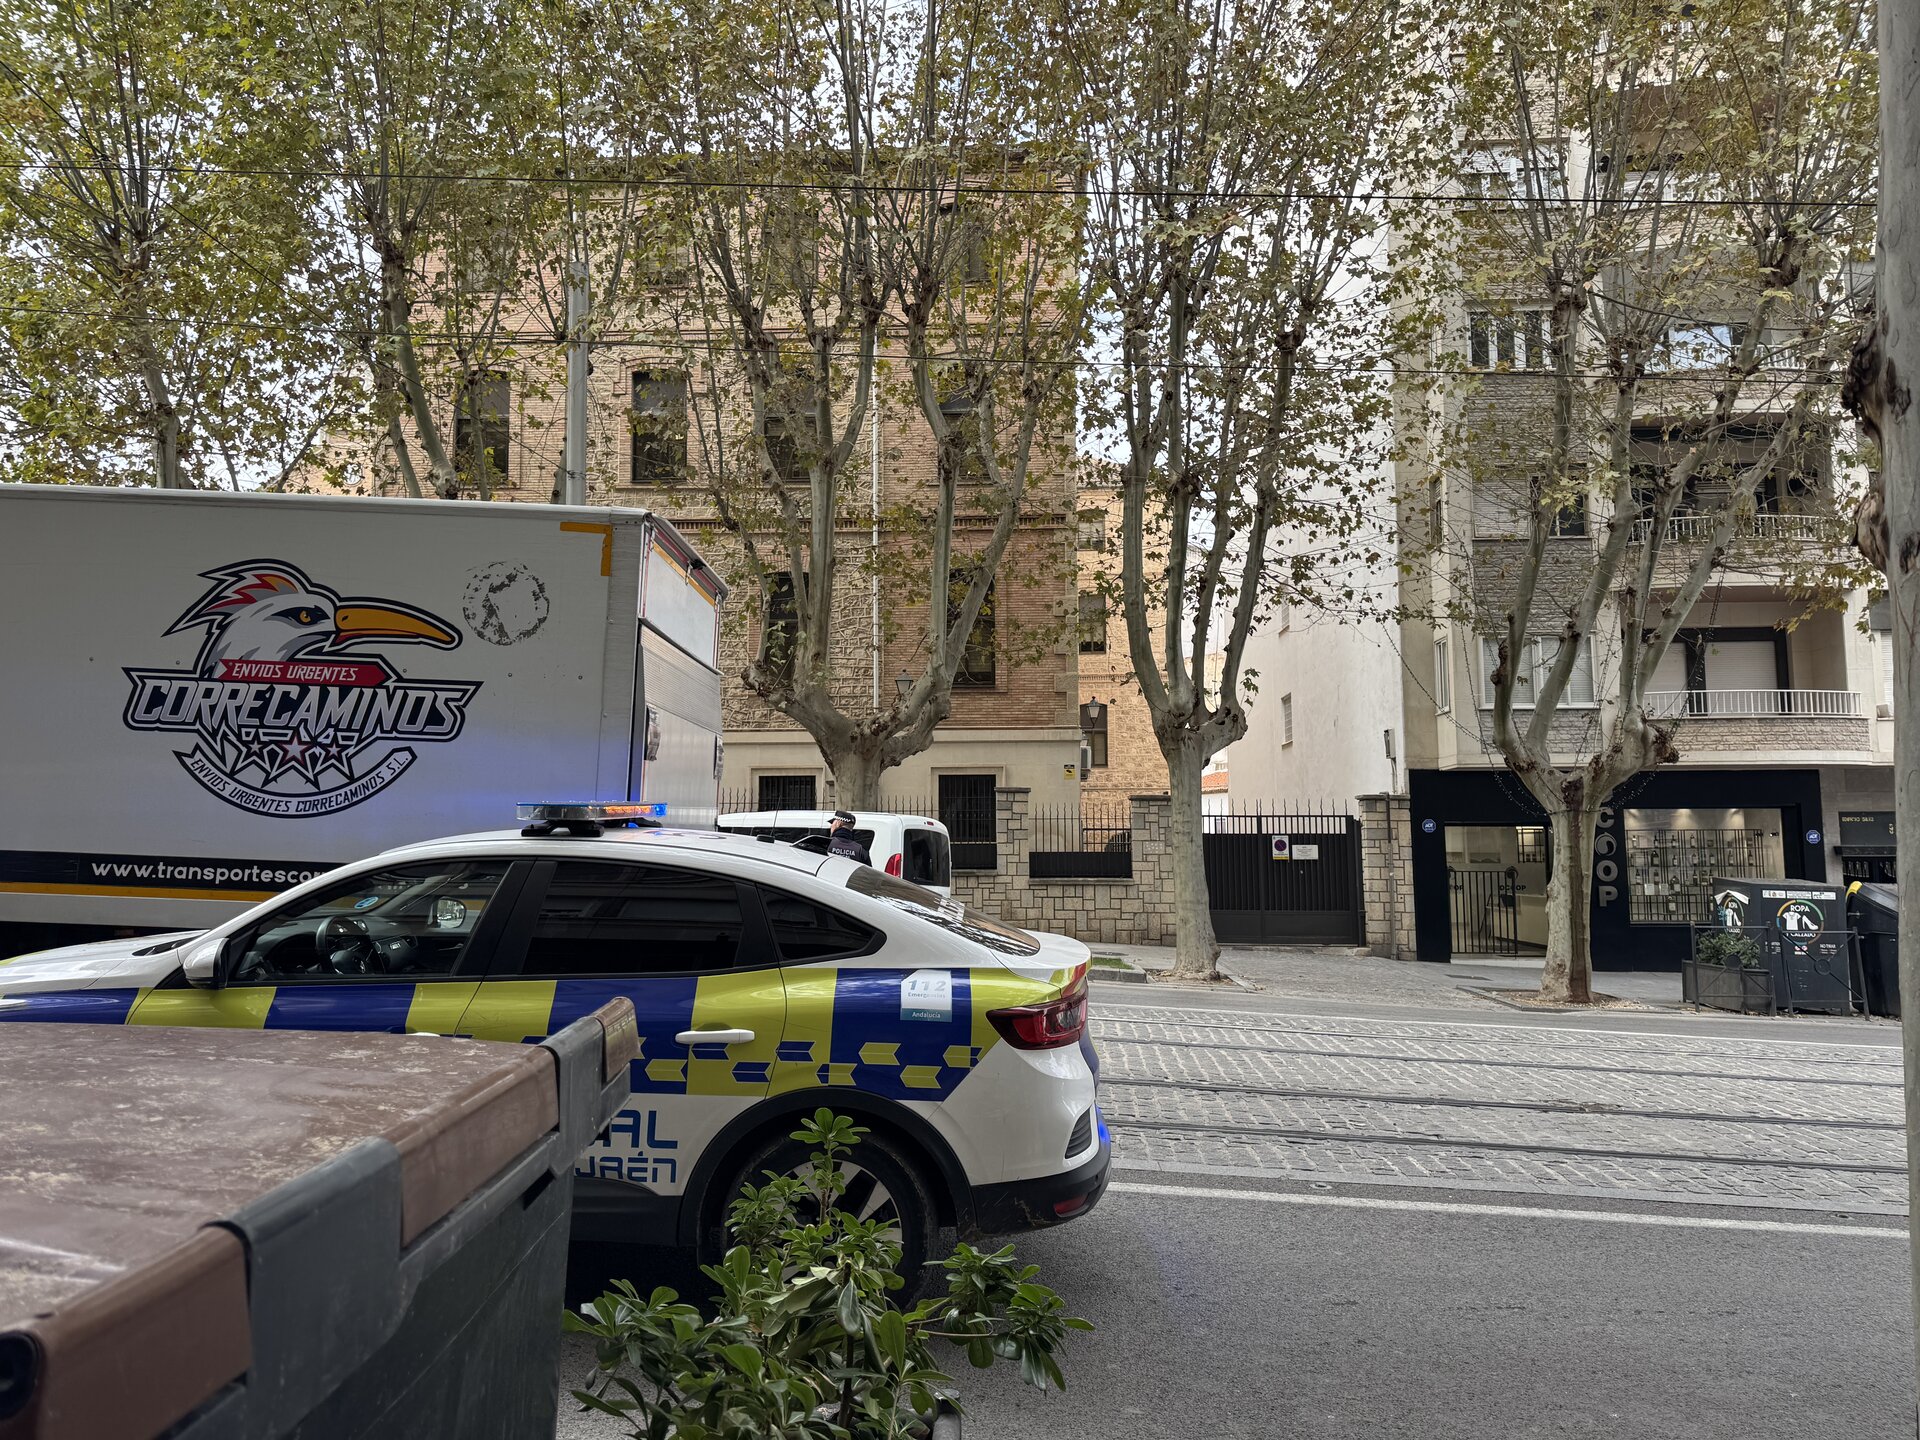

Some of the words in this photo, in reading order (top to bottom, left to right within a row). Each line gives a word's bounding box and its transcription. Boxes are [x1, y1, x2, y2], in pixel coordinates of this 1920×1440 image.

[231, 662, 283, 678] ENVIOS
[286, 664, 359, 682] URGENTES
[134, 678, 464, 740] CORRECAMINOS
[190, 754, 231, 792] ENVIOS
[228, 787, 291, 813] URGENTES
[295, 773, 386, 813] CORRECAMINOS
[390, 756, 408, 776] S.L.
[91, 861, 327, 884] www.transportescor
[1790, 904, 1810, 913] ROPA
[907, 979, 946, 991] 112
[588, 1109, 678, 1149] AL
